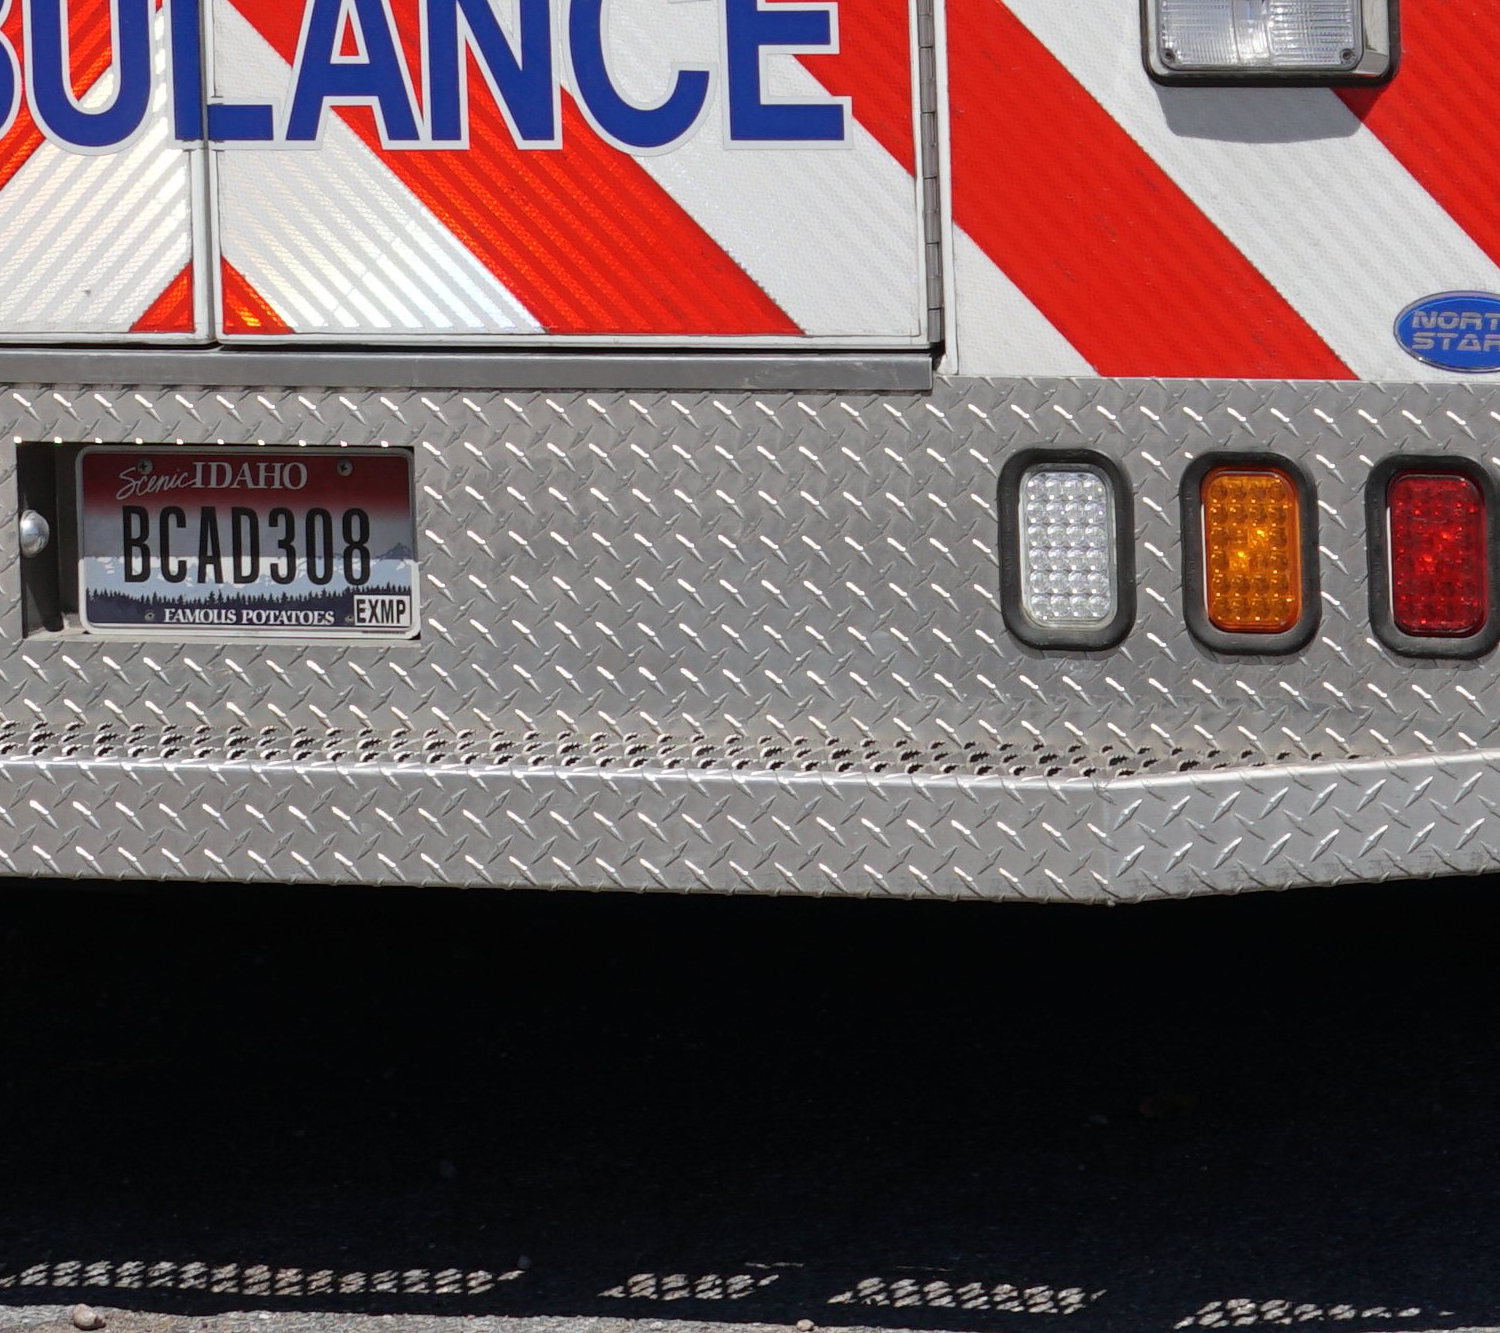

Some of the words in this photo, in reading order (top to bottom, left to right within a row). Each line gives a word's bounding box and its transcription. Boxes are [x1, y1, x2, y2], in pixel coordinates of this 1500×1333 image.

[115, 465, 197, 500] Scenic
[191, 460, 308, 491] IDAHO
[121, 505, 371, 587] BCAD308
[163, 607, 237, 625] FAMOUS
[241, 607, 335, 626] POTATOES
[356, 598, 407, 625] EXMP
